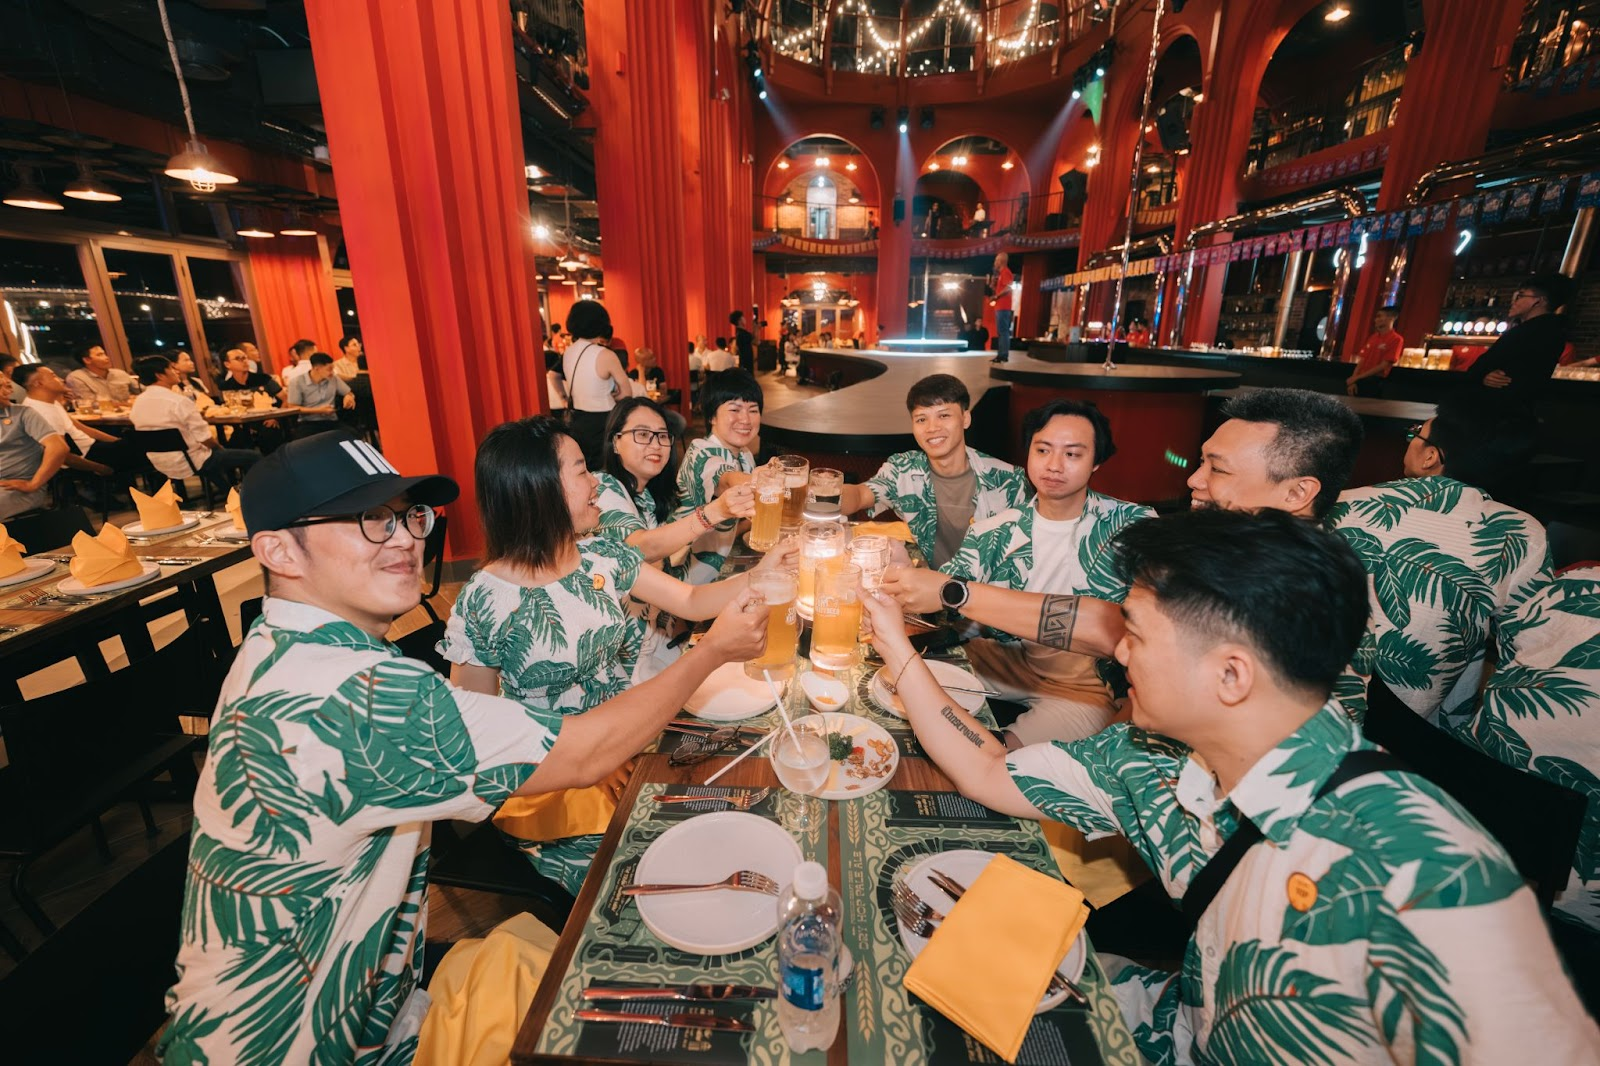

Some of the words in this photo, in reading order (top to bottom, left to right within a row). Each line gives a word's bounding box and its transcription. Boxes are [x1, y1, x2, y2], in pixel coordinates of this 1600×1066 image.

[853, 851, 862, 869] ALE
[854, 871, 865, 897] PALE
[856, 899, 867, 922] HOP
[858, 925, 869, 950] DRY
